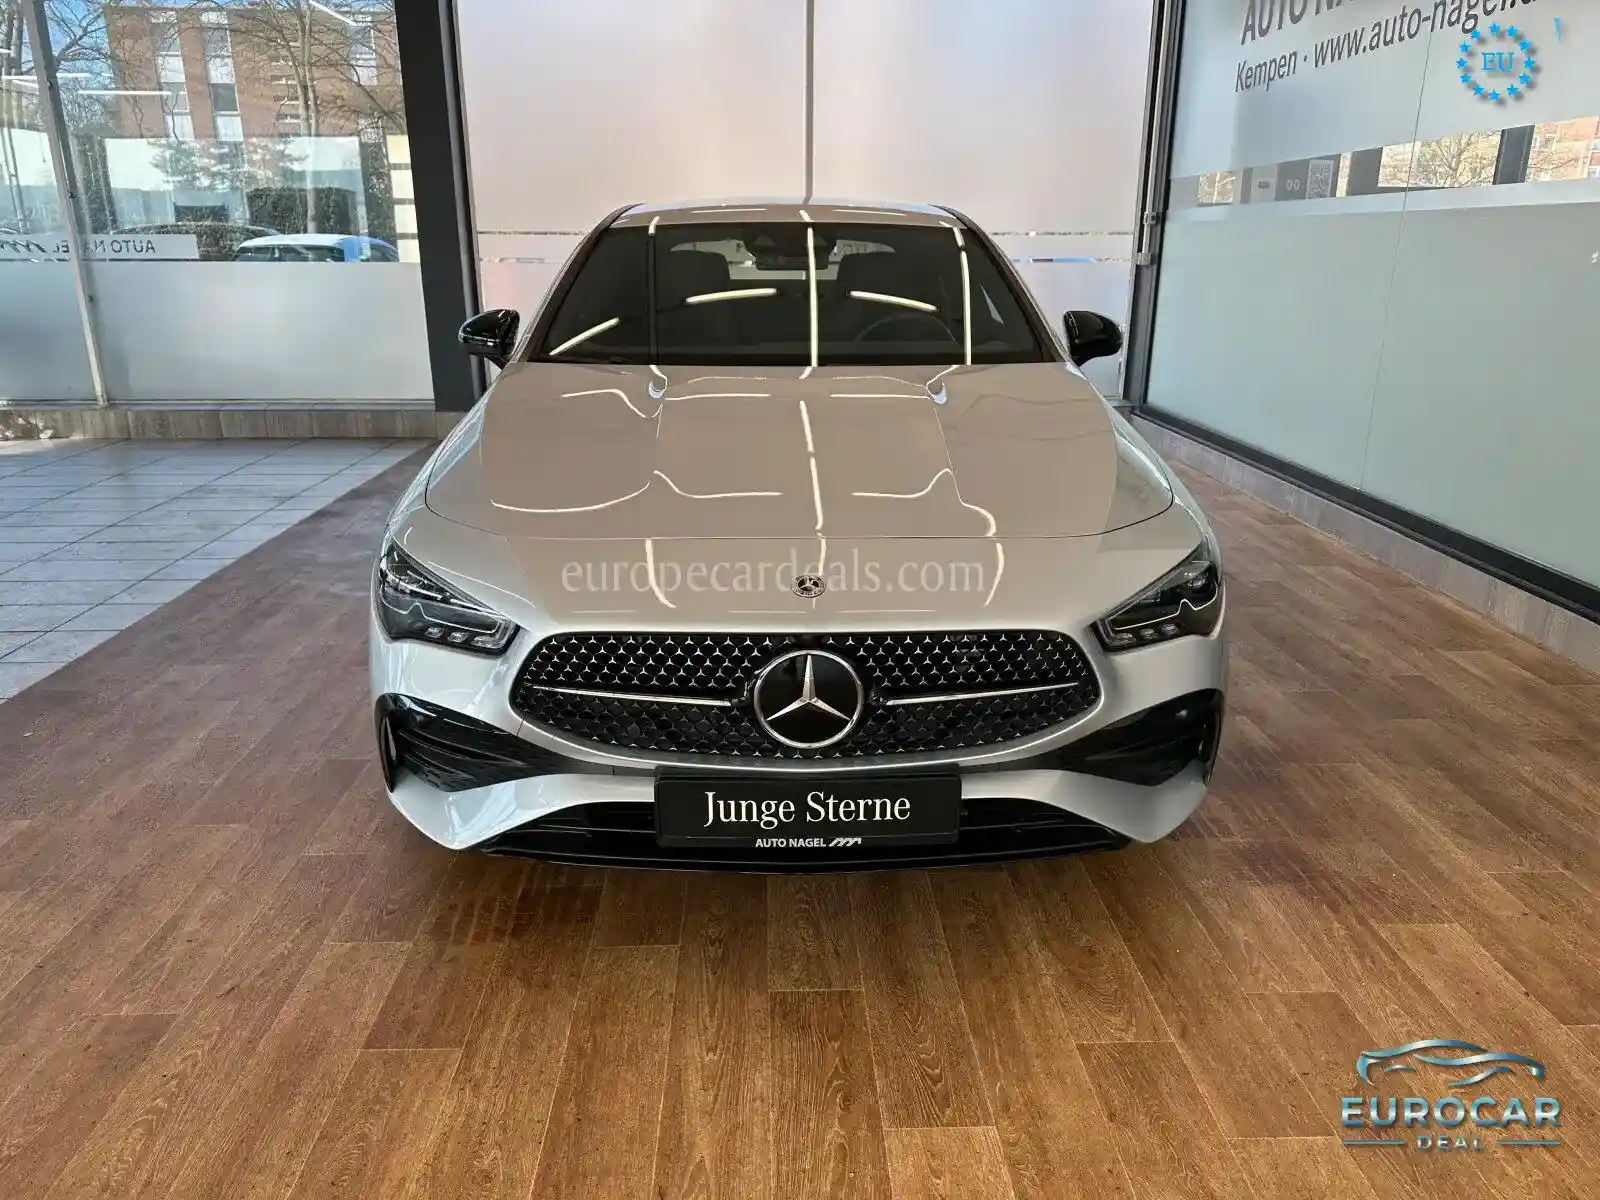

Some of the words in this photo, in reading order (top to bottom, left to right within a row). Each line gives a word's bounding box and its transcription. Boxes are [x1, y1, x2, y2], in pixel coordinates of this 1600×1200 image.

[1235, 51, 1297, 92] Kempen
[703, 791, 795, 830] Junge
[806, 791, 911, 822] Sterne
[755, 838, 787, 848] AUTO
[788, 838, 827, 848] NAGEL
